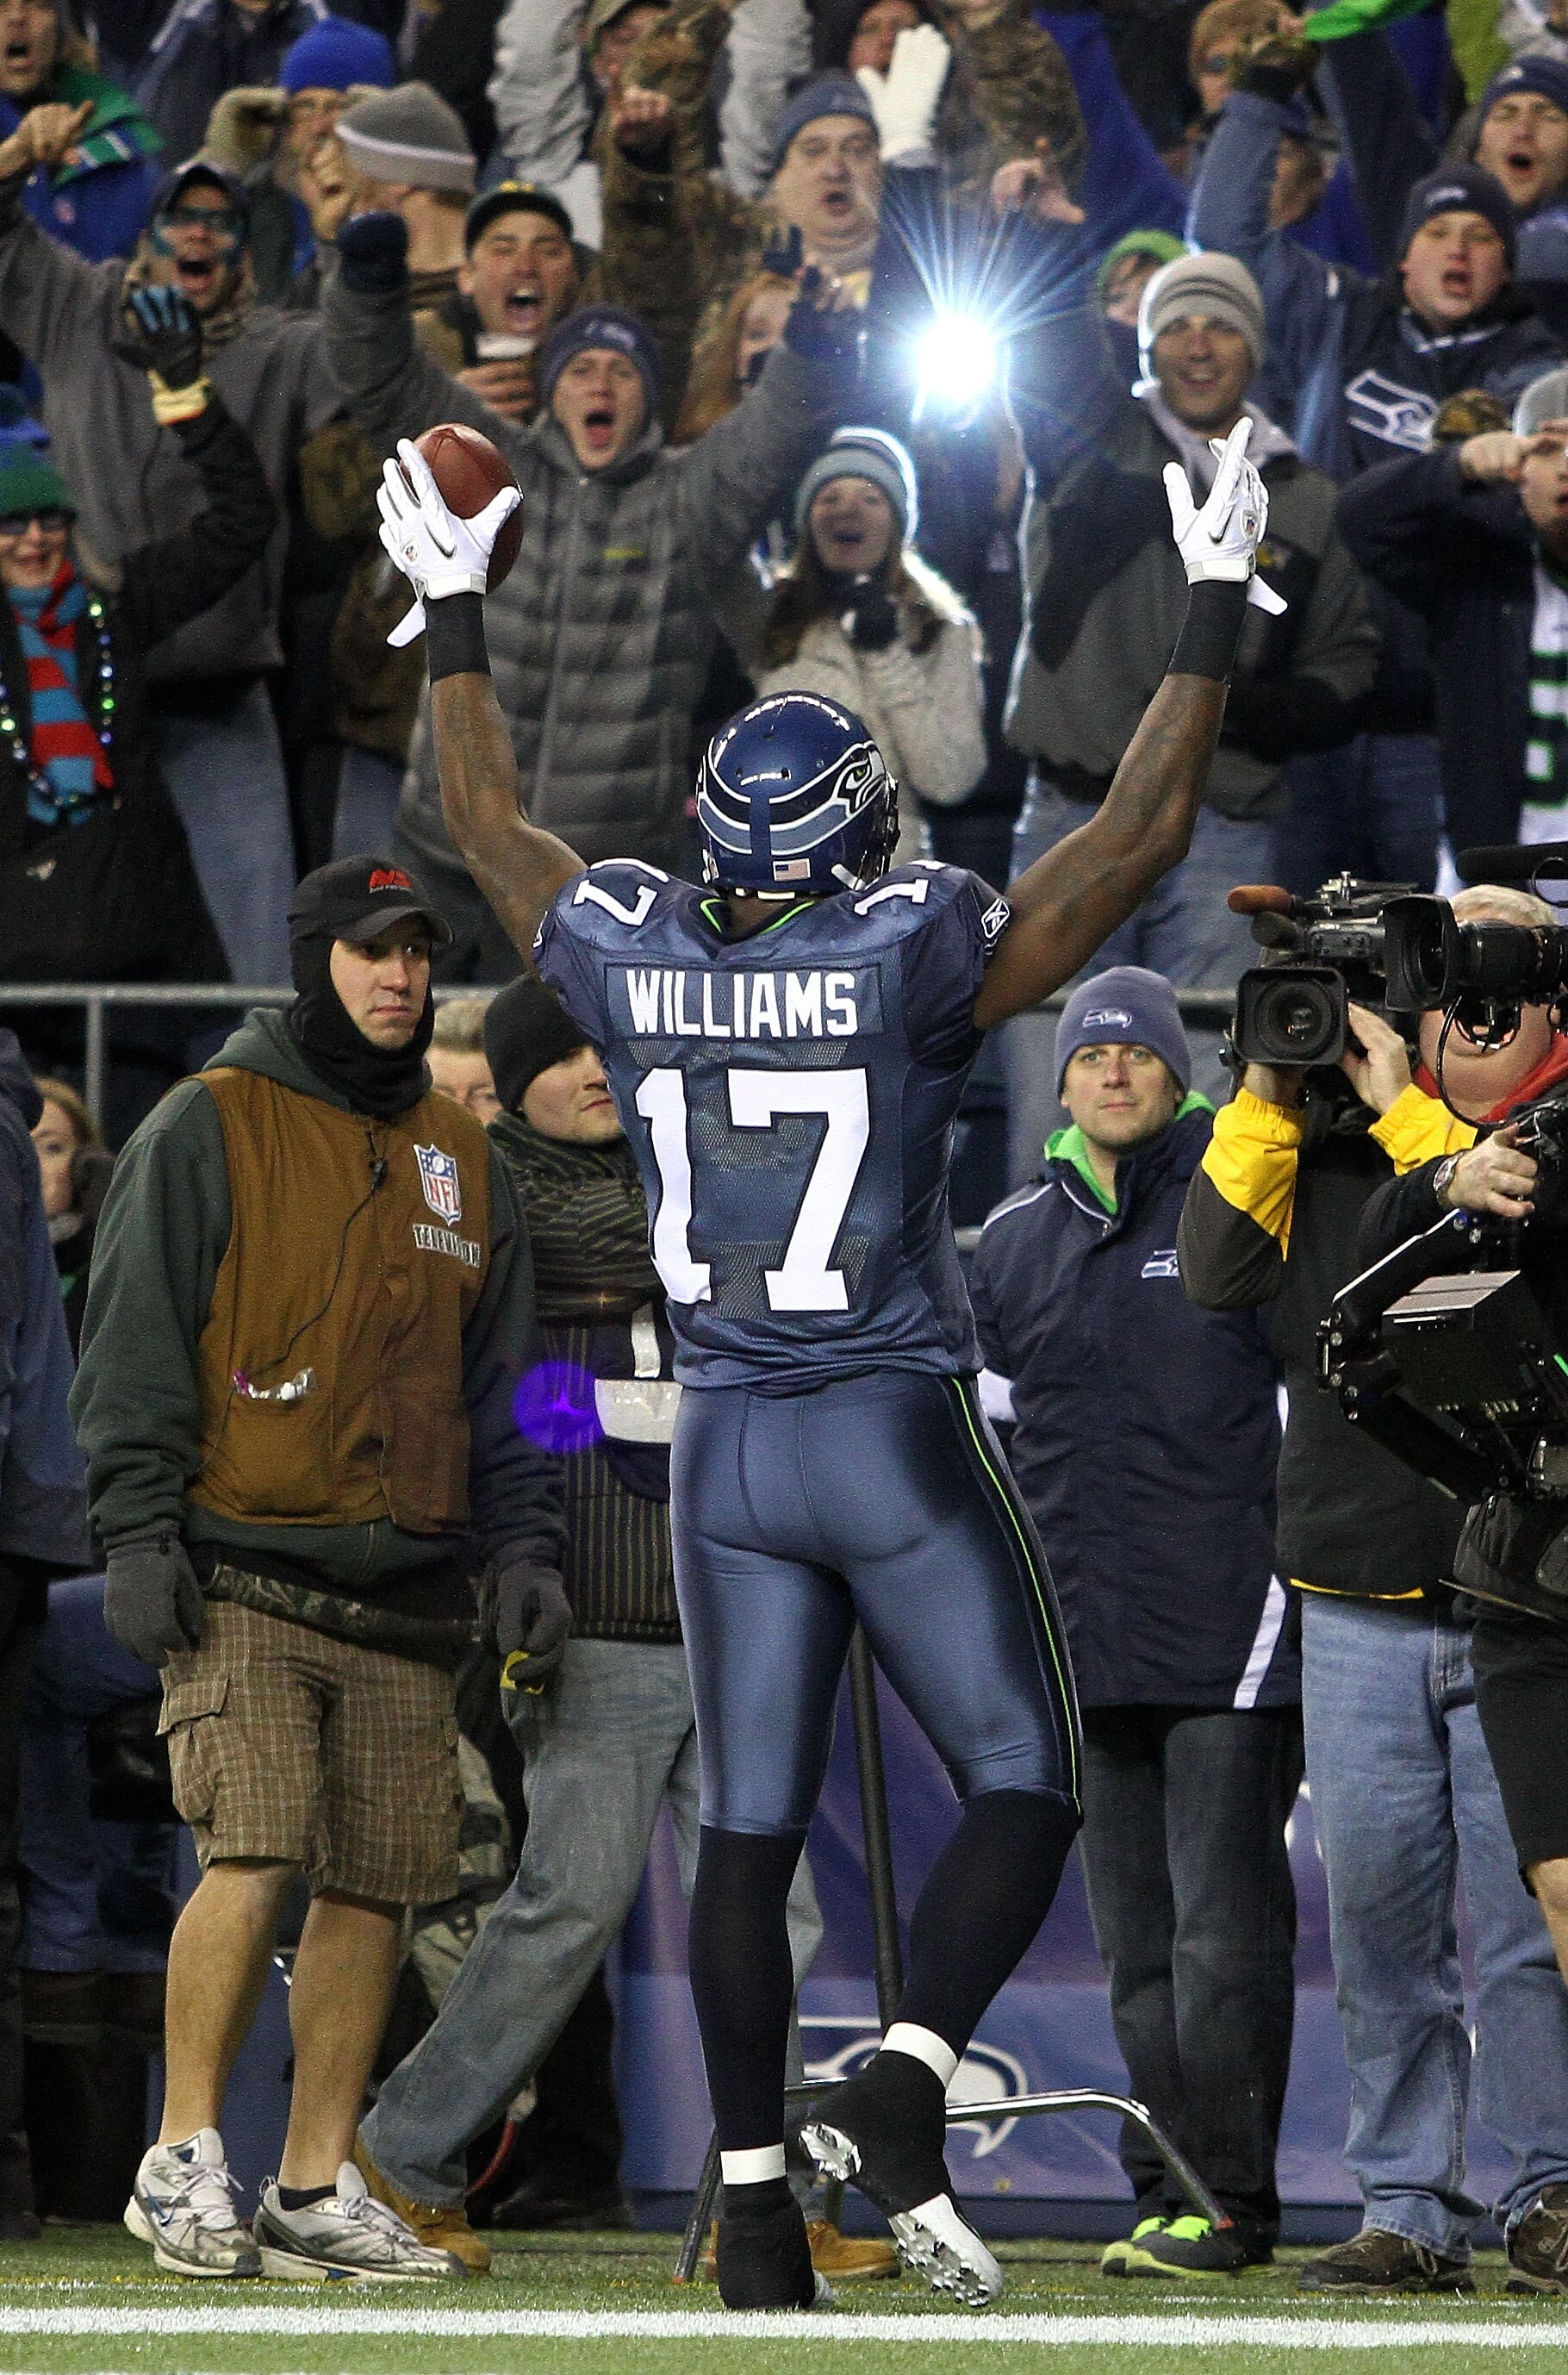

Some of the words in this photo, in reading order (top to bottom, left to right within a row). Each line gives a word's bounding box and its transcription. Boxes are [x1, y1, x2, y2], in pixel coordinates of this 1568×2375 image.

[625, 969, 859, 1038] WILLIAMS
[426, 1173, 461, 1212] NFL
[635, 1067, 870, 1311] 17
[412, 1223, 482, 1268] TELEVION
